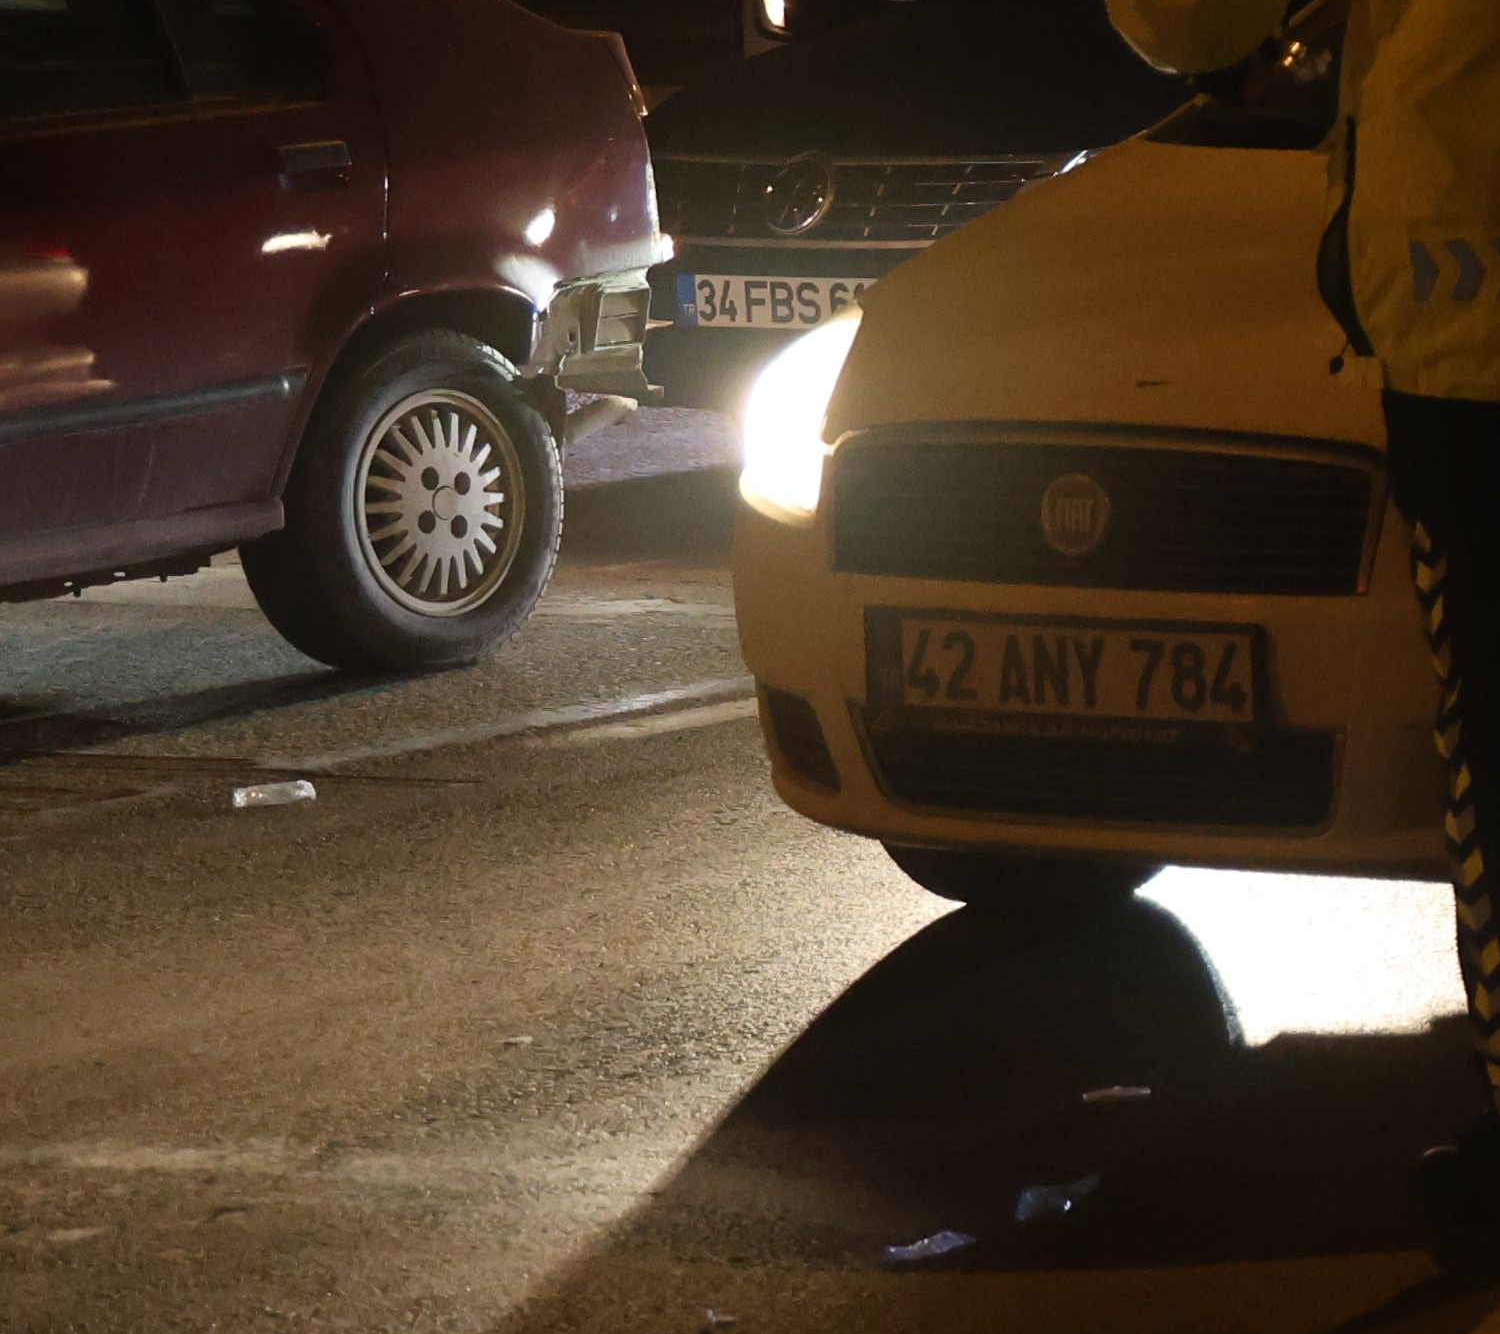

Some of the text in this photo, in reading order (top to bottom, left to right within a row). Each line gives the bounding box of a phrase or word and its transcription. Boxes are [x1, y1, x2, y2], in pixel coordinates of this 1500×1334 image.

[697, 279, 738, 322] 34
[744, 280, 821, 324] FBS
[904, 627, 978, 703] 42
[999, 633, 1105, 709] ANY
[1129, 638, 1248, 713] 784
